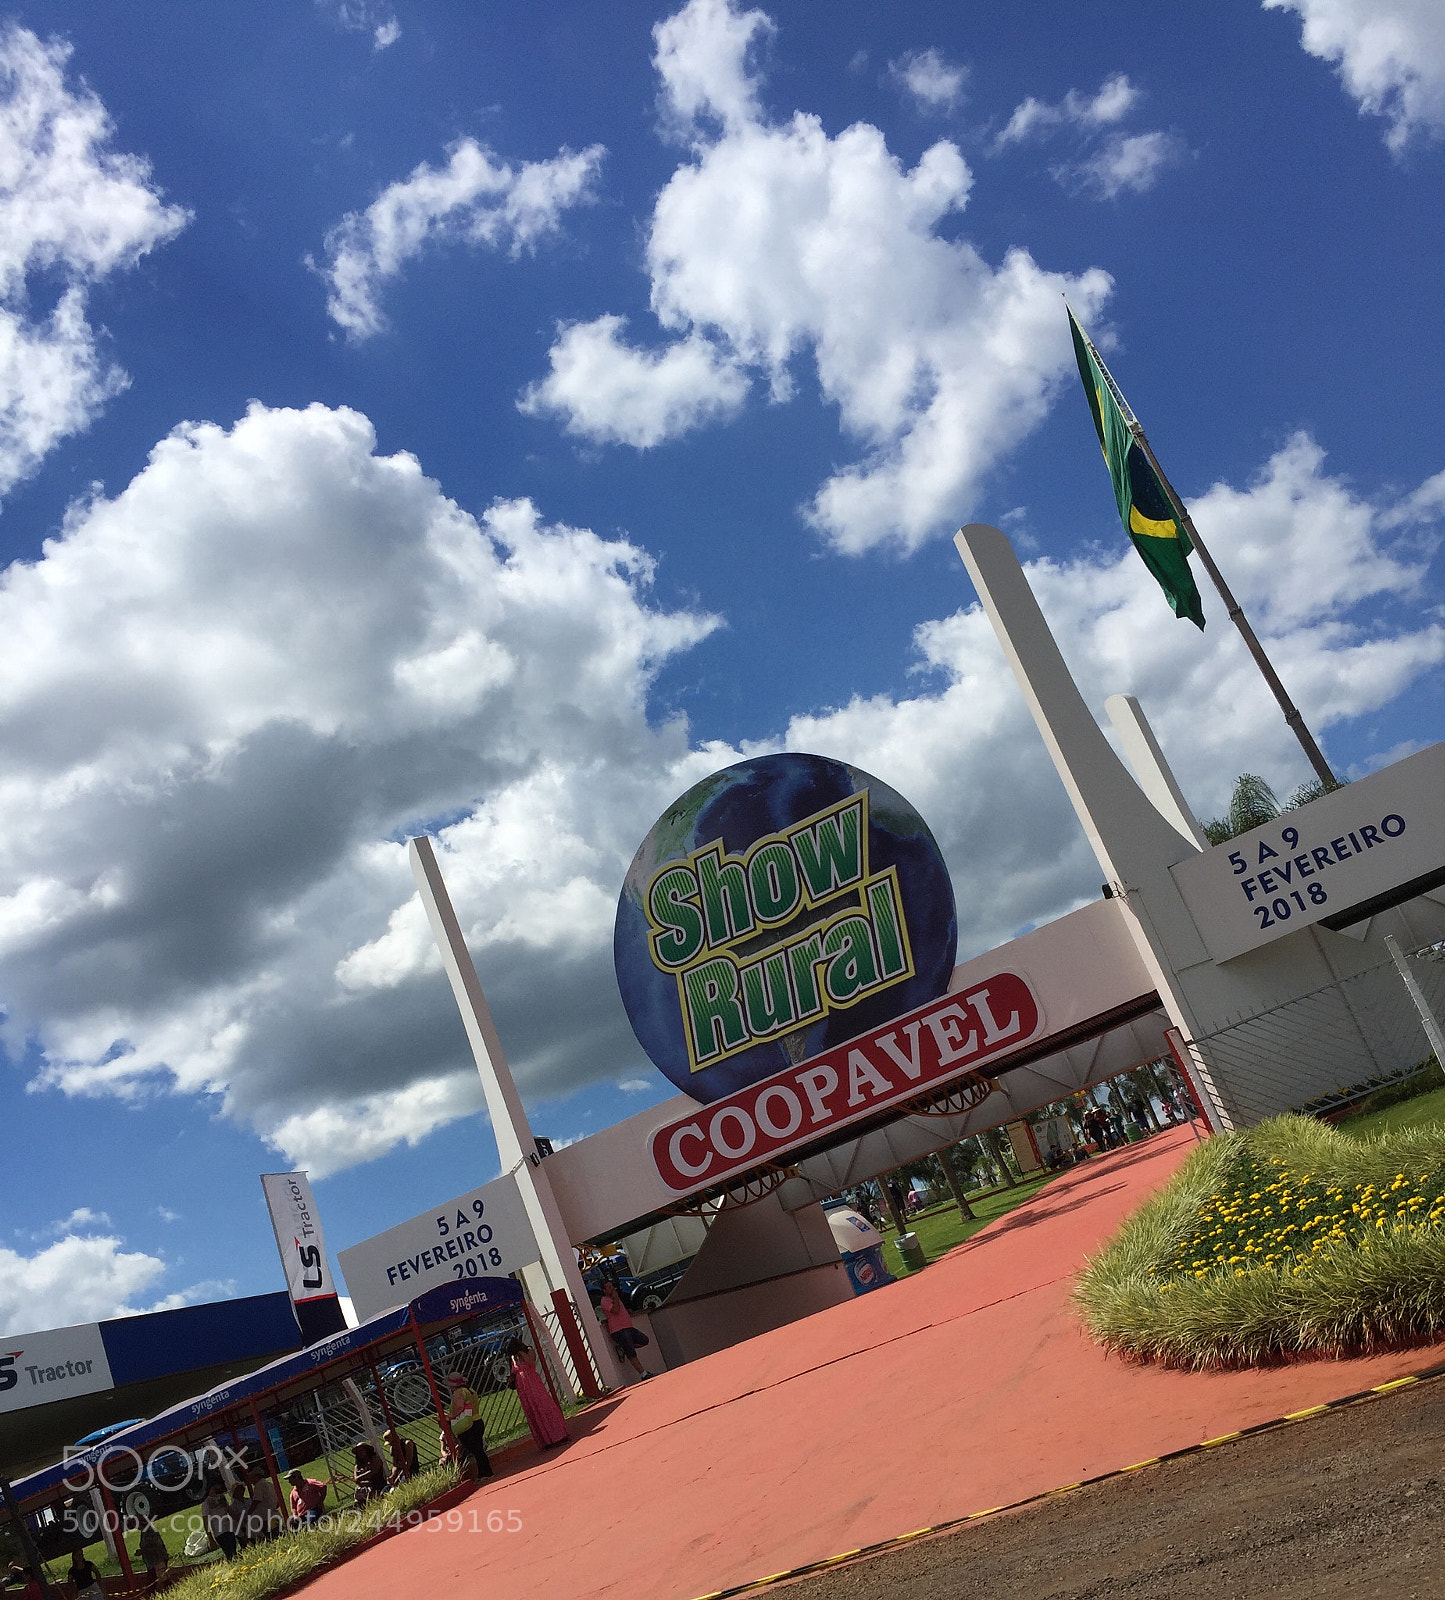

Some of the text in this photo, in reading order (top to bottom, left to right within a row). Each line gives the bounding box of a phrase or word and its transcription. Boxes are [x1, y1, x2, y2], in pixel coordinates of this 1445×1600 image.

[1228, 827, 1299, 875] 5 A 9
[1240, 814, 1406, 901] FEVEREIRO
[648, 801, 863, 968] Show
[1253, 882, 1328, 930] 2018
[682, 877, 907, 1063] Rural
[668, 988, 1021, 1178] COOPAVEL
[288, 1179, 323, 1289] LS Tractor
[436, 1199, 485, 1236] 5 A 9
[386, 1224, 493, 1286] FEVEREIRO
[453, 1247, 502, 1279] 2018
[449, 1289, 488, 1313] syngenta
[24, 1359, 93, 1385] Tractor
[310, 1335, 350, 1362] syngenta
[191, 1389, 230, 1415] syngenta
